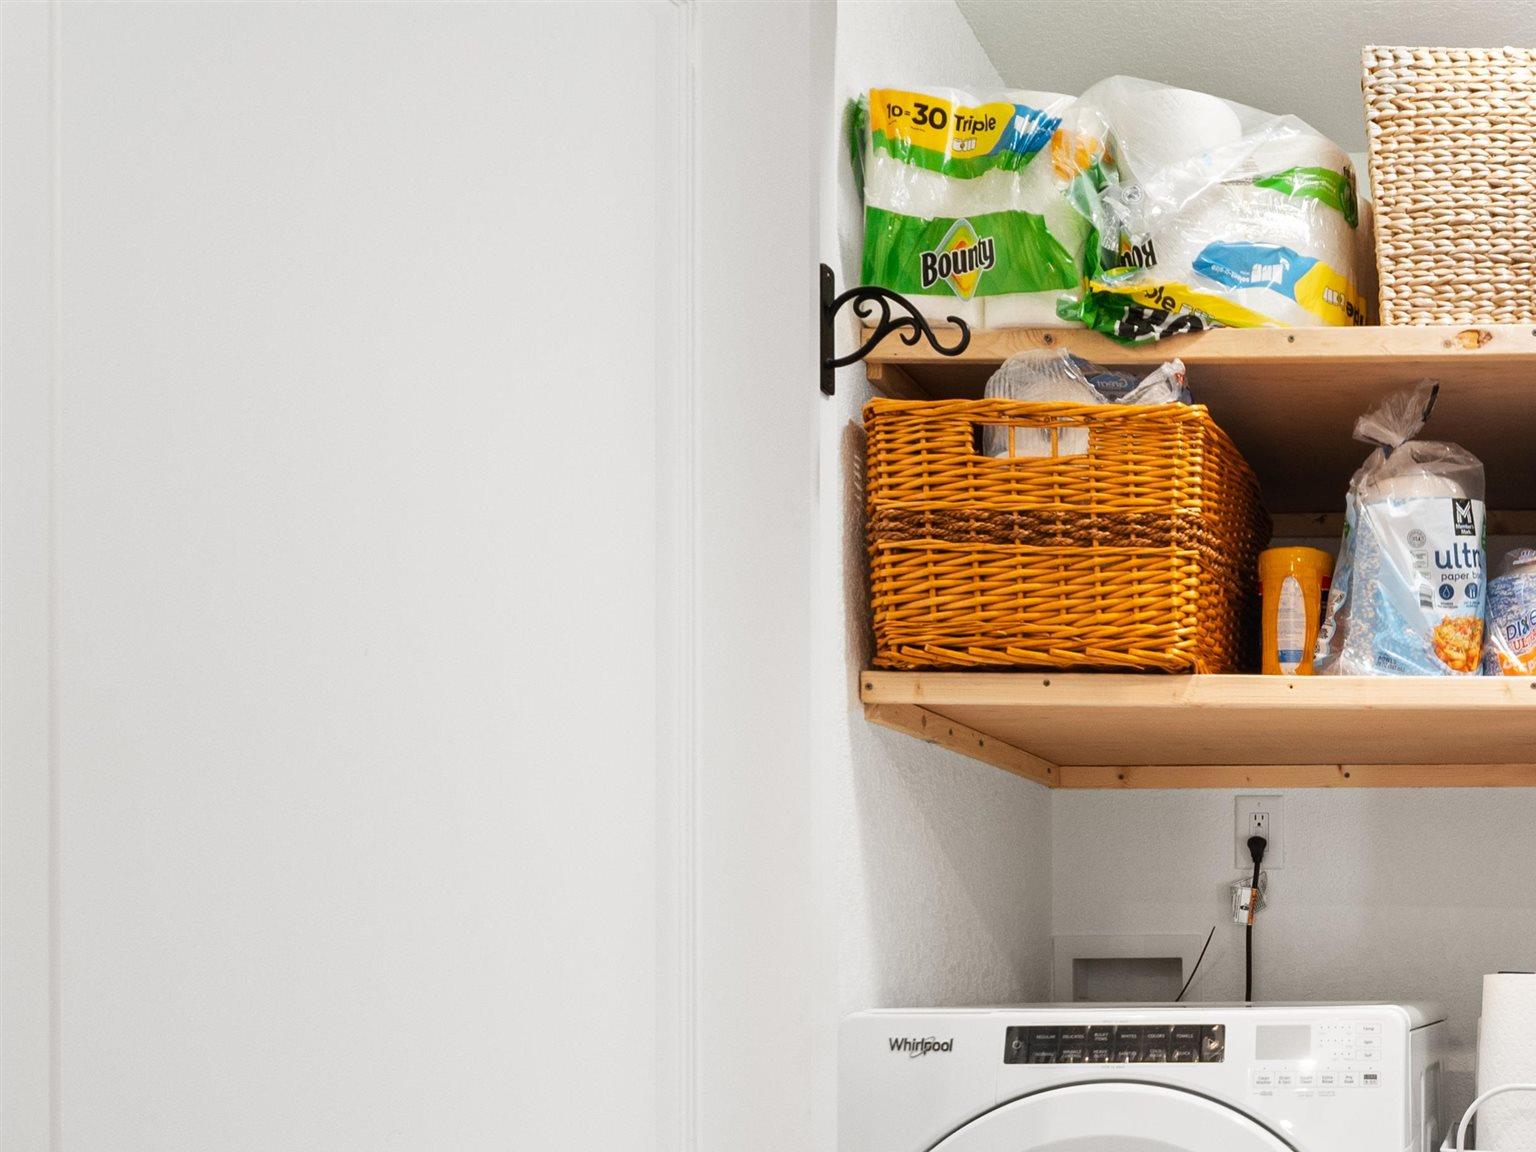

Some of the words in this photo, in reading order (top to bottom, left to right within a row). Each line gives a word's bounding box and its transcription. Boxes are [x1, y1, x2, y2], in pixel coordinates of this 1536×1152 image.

[954, 113, 997, 134] Triple
[921, 237, 995, 288] Bounty
[1441, 571, 1470, 582] paper
[889, 1037, 954, 1058] Whirlpool
